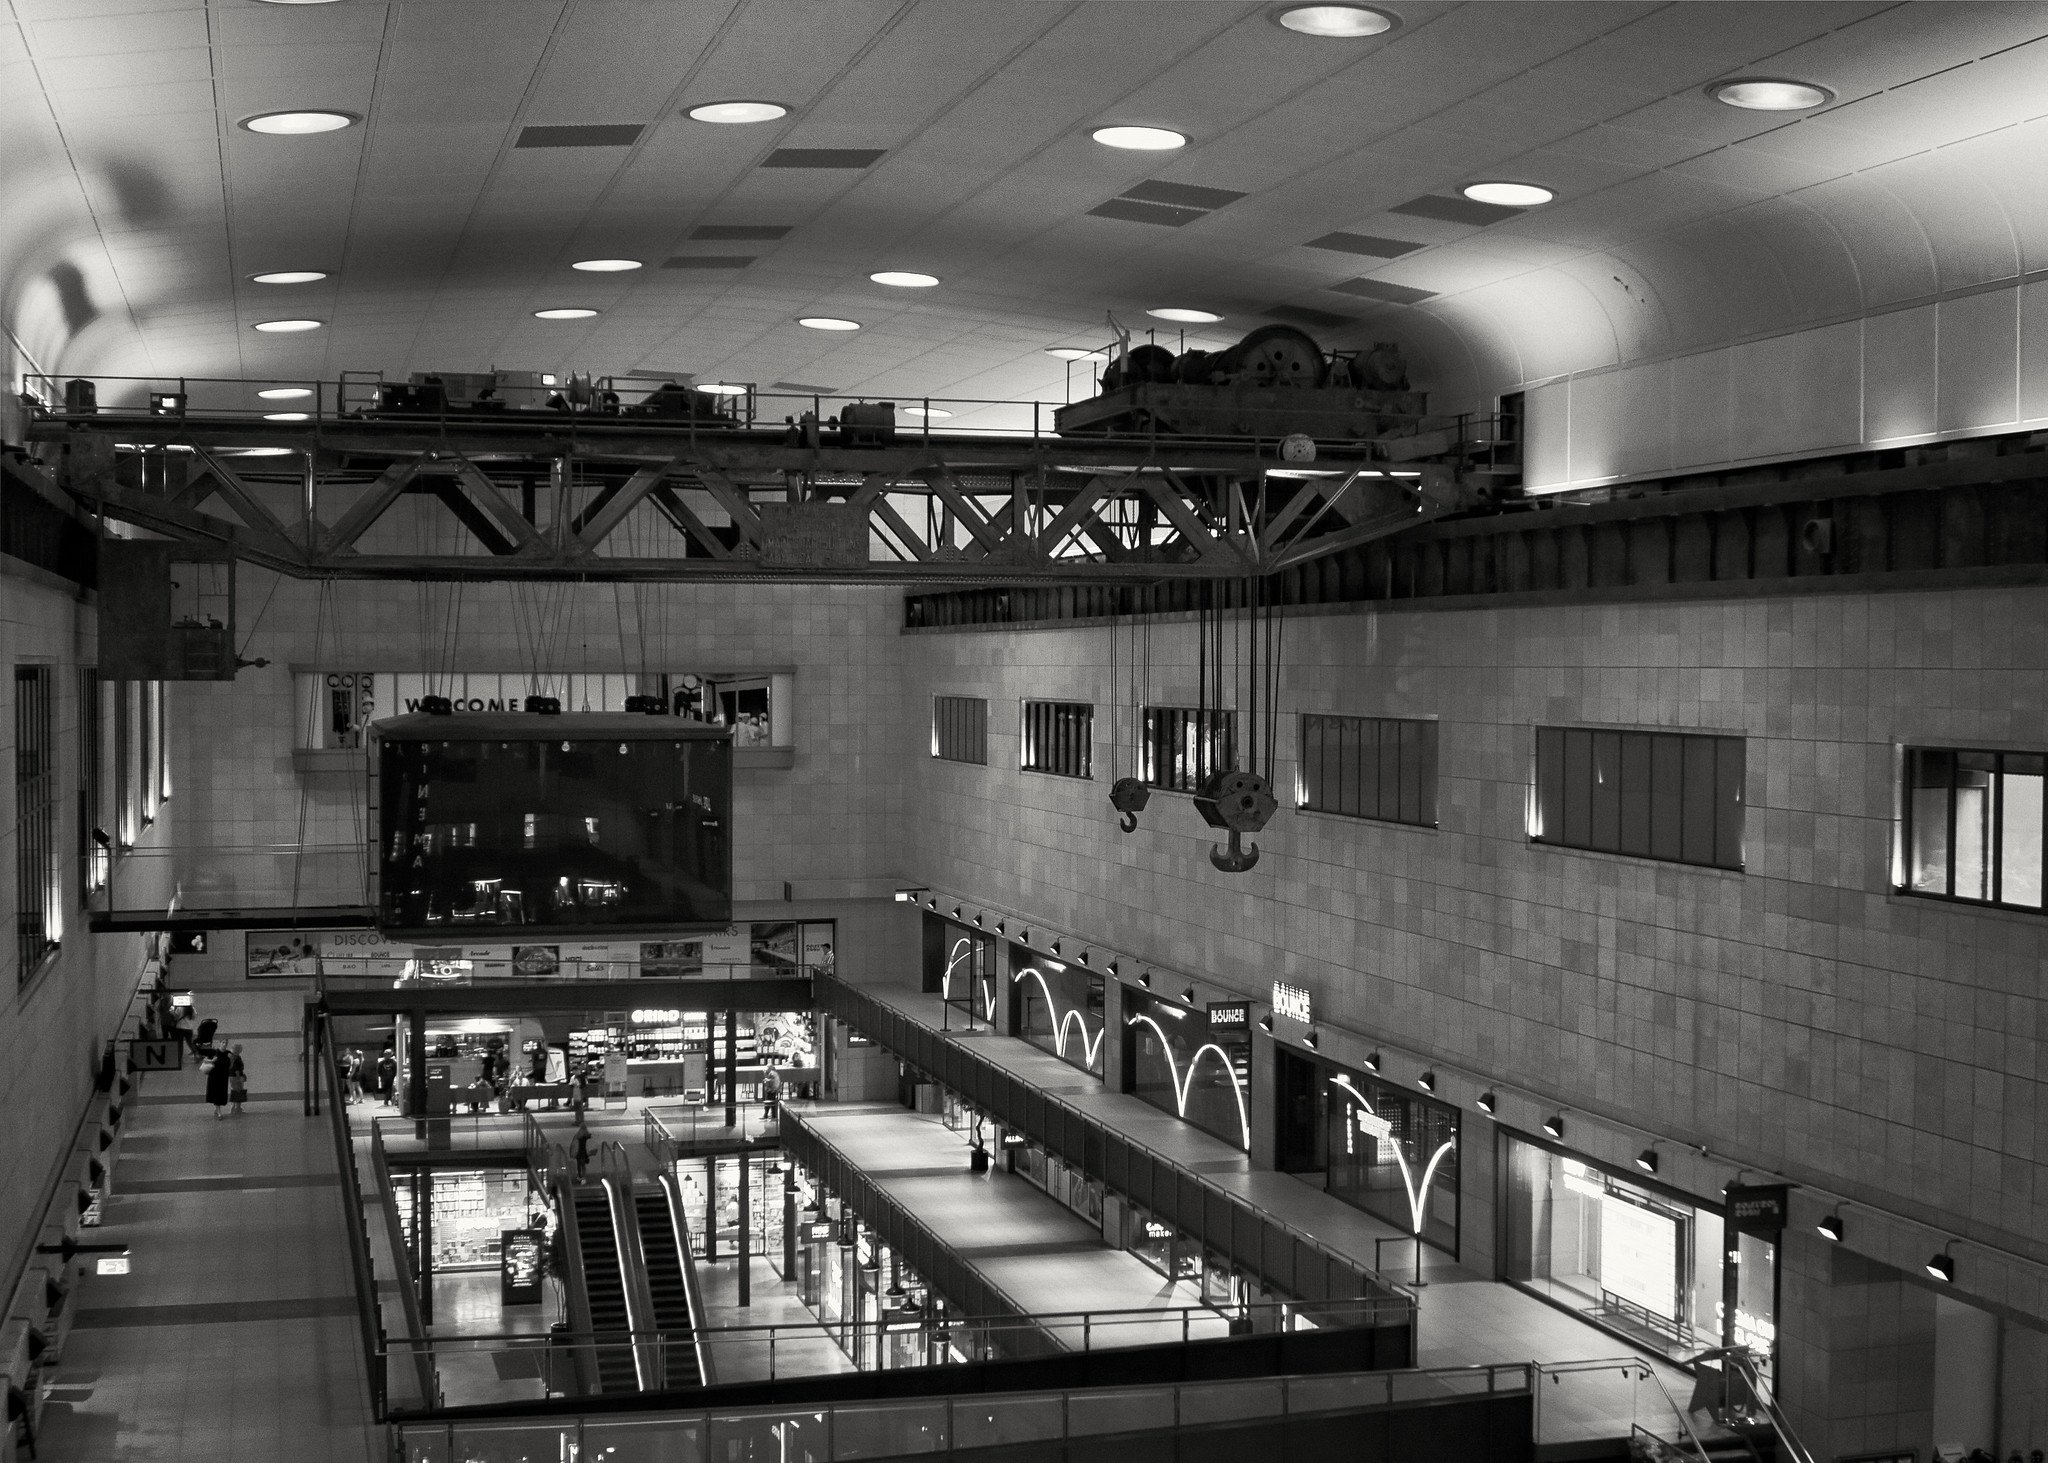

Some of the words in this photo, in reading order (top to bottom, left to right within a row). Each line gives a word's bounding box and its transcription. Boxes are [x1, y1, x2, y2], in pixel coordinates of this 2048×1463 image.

[405, 698, 518, 713] WCOME
[1273, 980, 1311, 1024] BOUNCE
[1210, 1008, 1246, 1024] BOUNCE
[145, 1044, 167, 1067] N
